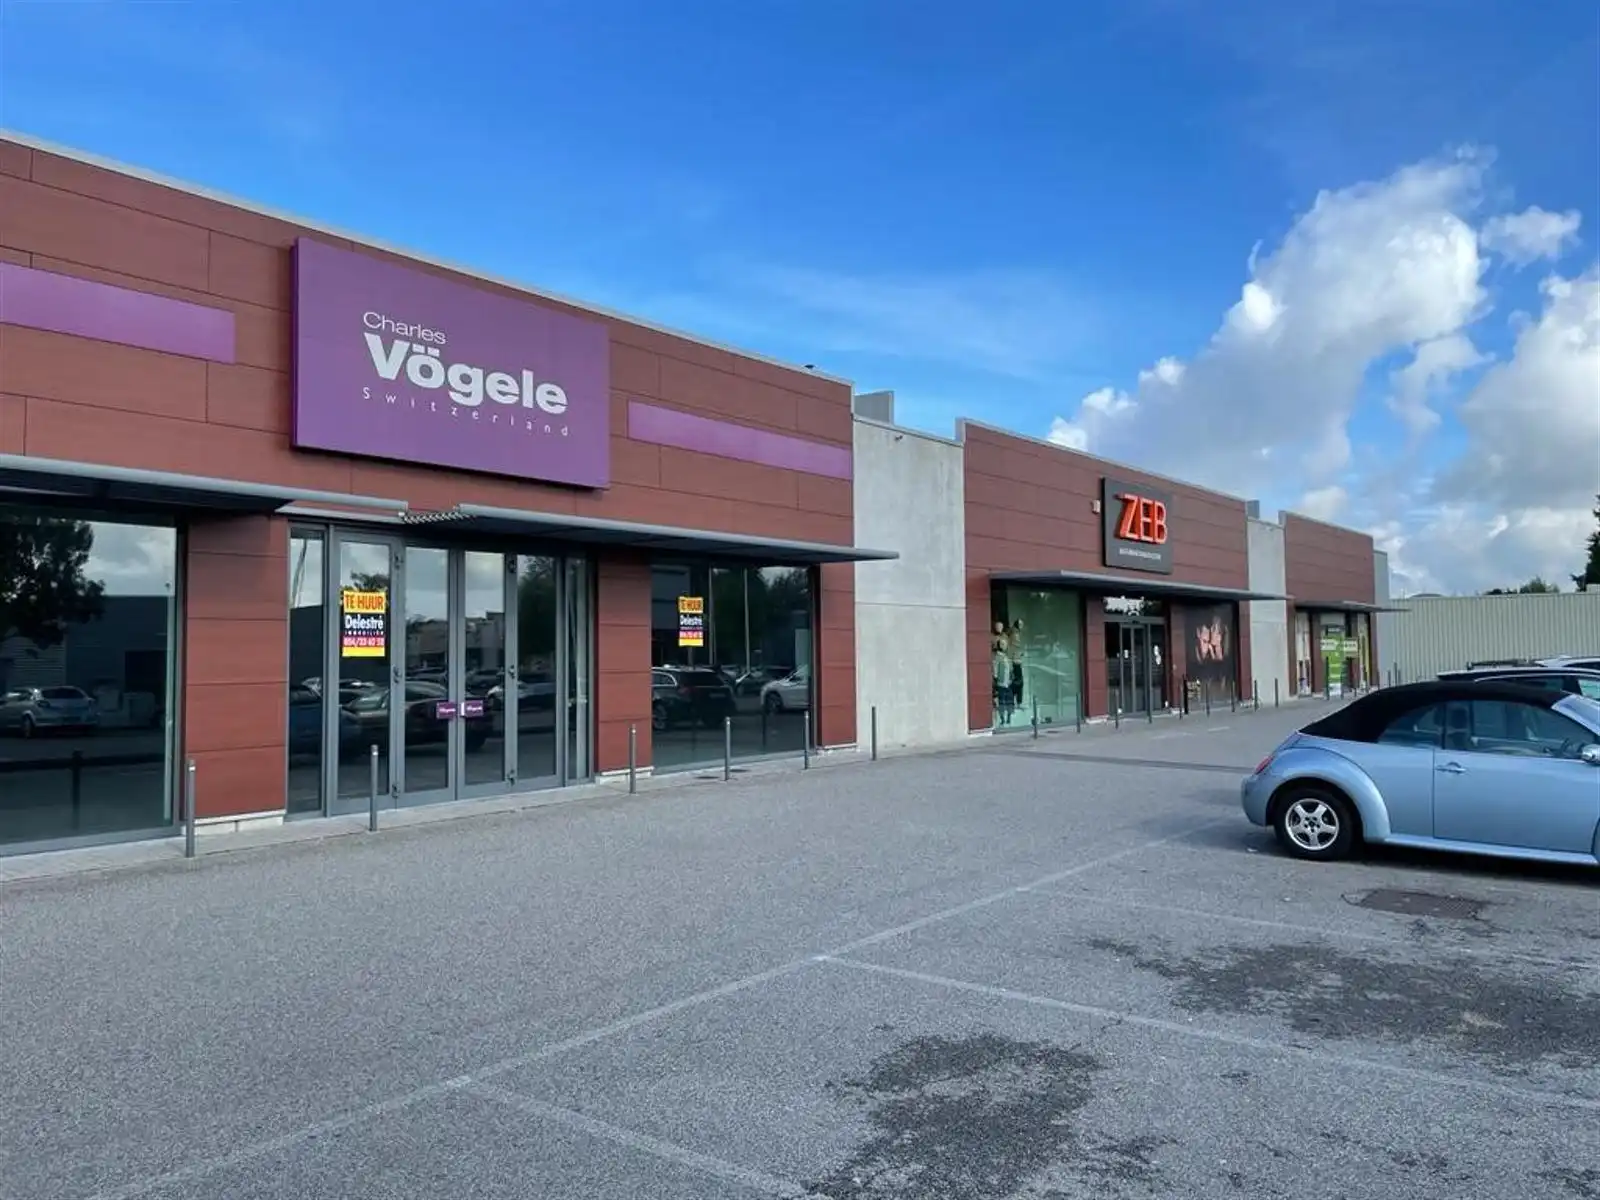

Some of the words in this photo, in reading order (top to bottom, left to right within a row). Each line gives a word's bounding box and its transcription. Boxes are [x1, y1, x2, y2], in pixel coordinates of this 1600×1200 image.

[363, 311, 447, 345] Charles
[363, 332, 568, 415] Vögele
[362, 386, 569, 437] Switzerland
[1114, 493, 1168, 545] ZEB
[345, 594, 355, 609] TE
[357, 595, 384, 610] HUUR
[345, 614, 384, 629] Delestré
